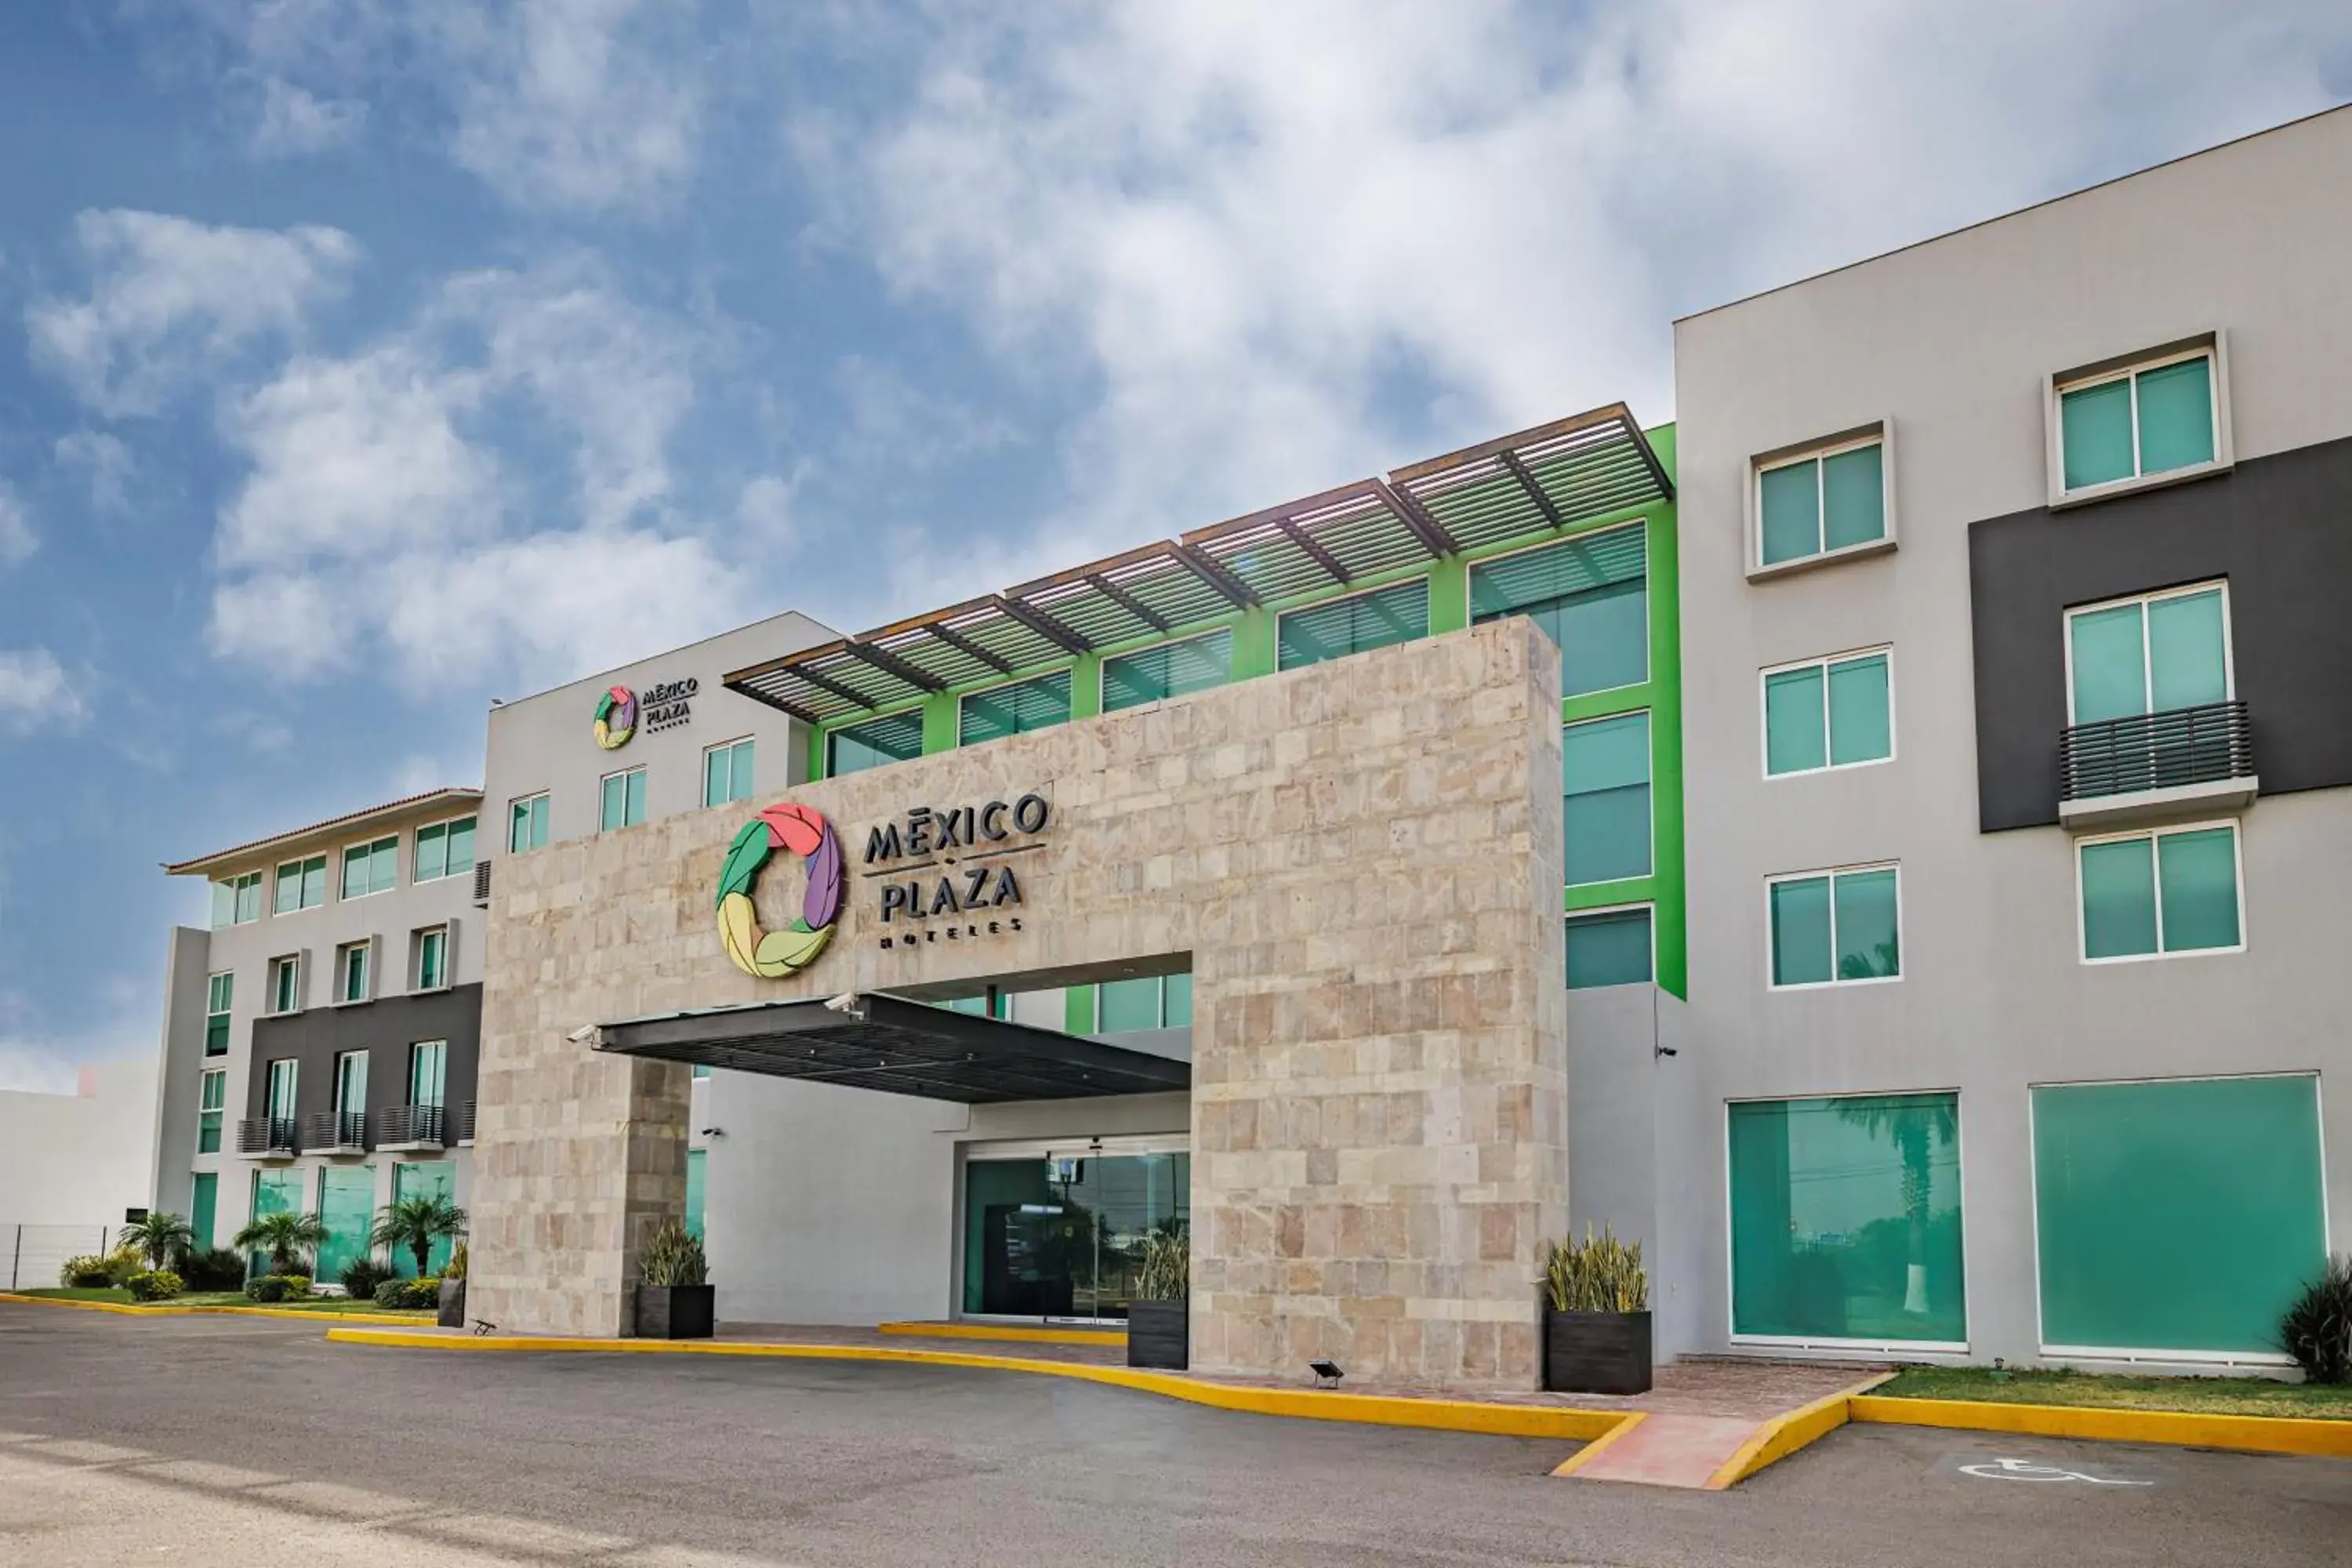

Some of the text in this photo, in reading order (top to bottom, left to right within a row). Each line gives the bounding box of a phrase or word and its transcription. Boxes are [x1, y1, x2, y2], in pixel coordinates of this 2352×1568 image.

[647, 702, 691, 725] PLAZA
[880, 866, 1022, 923] PLAZA
[880, 917, 1022, 949] HOTELES
